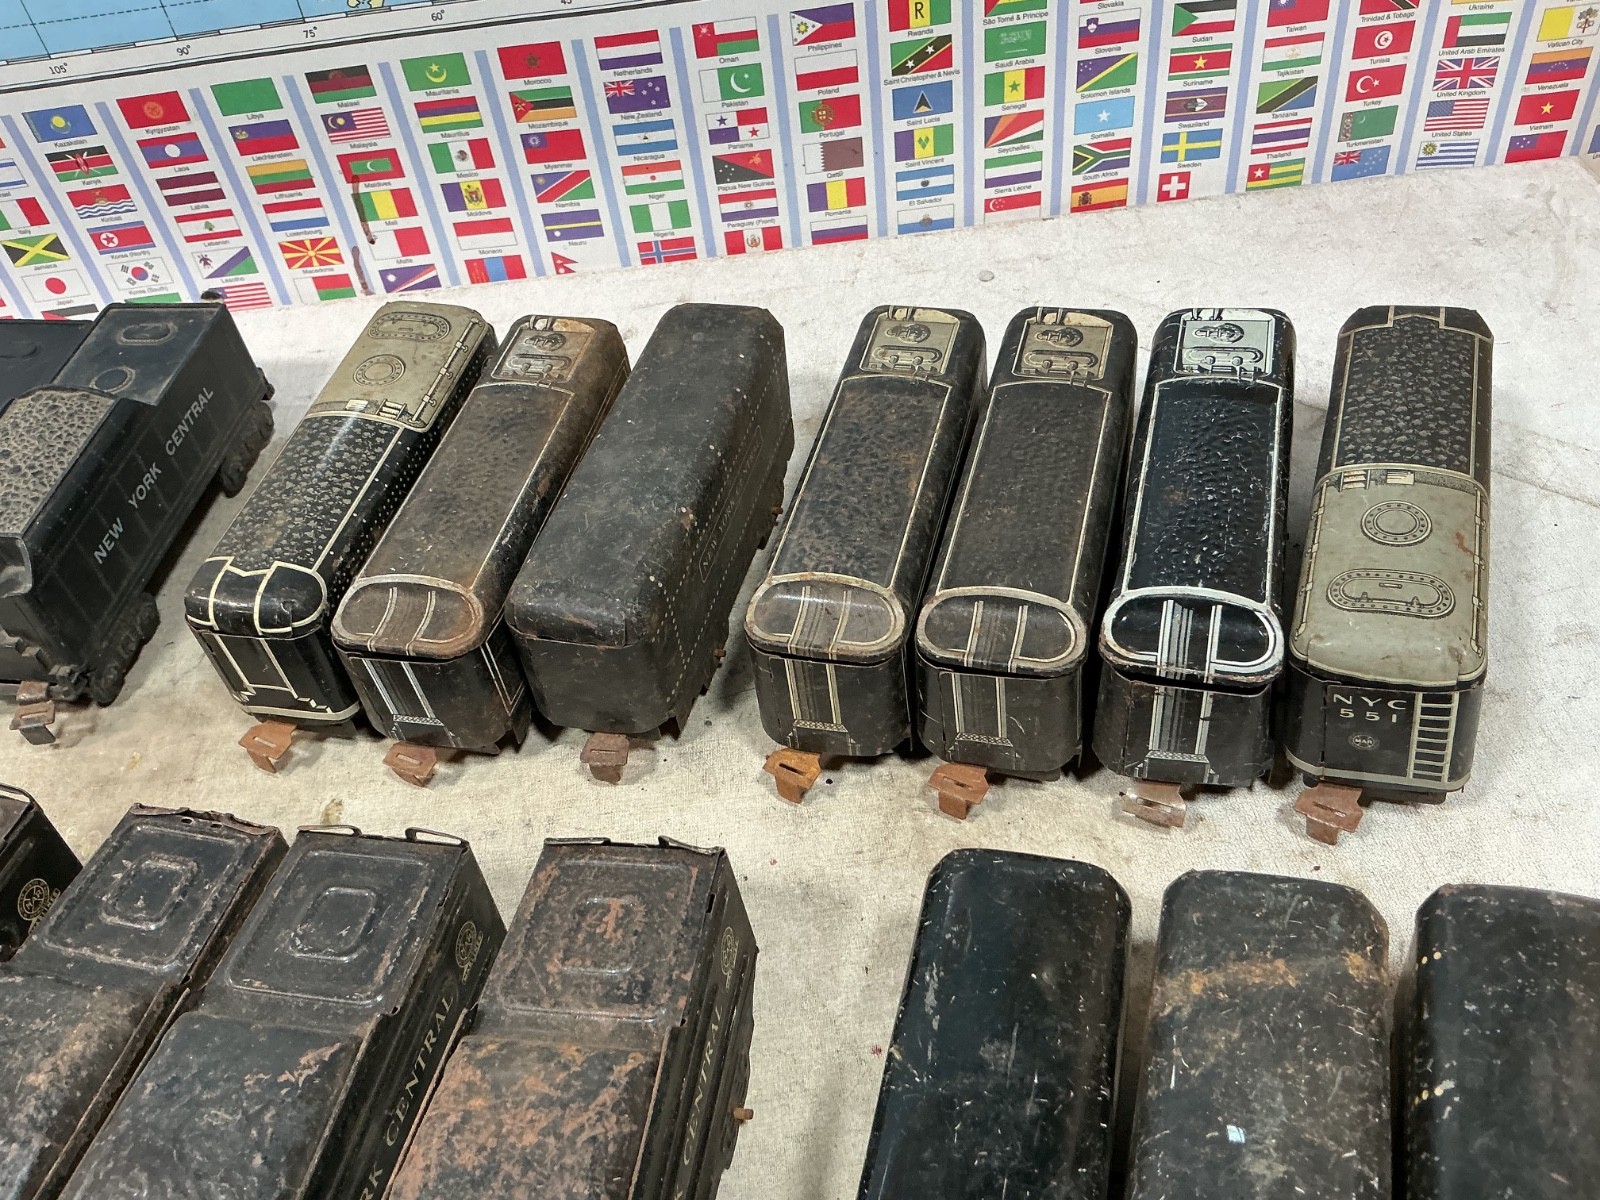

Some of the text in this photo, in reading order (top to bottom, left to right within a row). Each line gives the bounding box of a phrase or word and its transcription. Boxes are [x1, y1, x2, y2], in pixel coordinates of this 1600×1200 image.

[1098, 1, 1124, 10] Slovakia
[914, 2, 925, 20] R
[431, 10, 445, 22] 60°
[1361, 14, 1386, 22] Trinidad
[1392, 11, 1415, 20] Tobago
[303, 26, 318, 38] 75°
[1286, 24, 1308, 32] Taiwan
[908, 28, 934, 38] Rwanda
[176, 44, 192, 56] 90°
[808, 42, 842, 52] Philippines
[1094, 45, 1122, 54] Slovenia
[1014, 58, 1035, 66] Arabia
[1370, 57, 1390, 65] Tunisia
[49, 62, 68, 76] 105°
[614, 67, 652, 77] Netherlands
[1277, 68, 1304, 78] Tajikistan
[524, 78, 552, 86] Morocco
[884, 78, 900, 86] Saint
[900, 72, 937, 84] Christopher
[943, 69, 960, 77] Nevis
[1182, 79, 1214, 88] Suriname
[1538, 82, 1569, 90] Venezuela
[425, 88, 460, 98] Mauritania
[818, 87, 840, 96] Poland
[1080, 87, 1131, 100] Solomon Islands
[1458, 90, 1486, 98] Kingdom
[722, 100, 748, 108] Pakistan
[1002, 102, 1027, 112] Senegal
[246, 112, 264, 120] Libya
[637, 110, 662, 120] Zealand
[1272, 111, 1298, 120] Tanzania
[528, 120, 568, 130] Mozambique
[906, 116, 940, 126] Saint Lucia
[1178, 120, 1210, 130] Swaziland
[440, 130, 470, 139] Mauritius
[819, 130, 846, 138] Portugal
[1090, 131, 1115, 140] Somalia
[350, 141, 378, 150] Malaysia
[728, 142, 754, 150] Panama
[1346, 138, 1384, 148] Turkmenistan
[998, 144, 1030, 154] Seychelles
[252, 151, 294, 162] Liechtenstein
[633, 153, 666, 162] Nicaragua
[1266, 151, 1292, 160] Thailand
[544, 162, 572, 171] Myanmar
[905, 158, 944, 168] Saint Vincent
[456, 172, 478, 180] Mexico
[1082, 173, 1100, 182] South
[82, 178, 102, 186] Kenya
[364, 181, 392, 189] Maldives
[753, 180, 774, 188] Guinea
[994, 184, 1032, 194] Sierra Leone
[648, 192, 665, 200] Niger
[916, 196, 942, 205] Salvador
[466, 210, 492, 218] Moldova
[825, 209, 851, 217] Romania
[654, 230, 675, 238] Nigeria
[94, 387, 214, 564] NEW YORK CENTRAL
[1339, 708, 1398, 724] 551
[683, 1005, 722, 1165] CENTRAL
[359, 995, 454, 1200] RK CENTRAL
